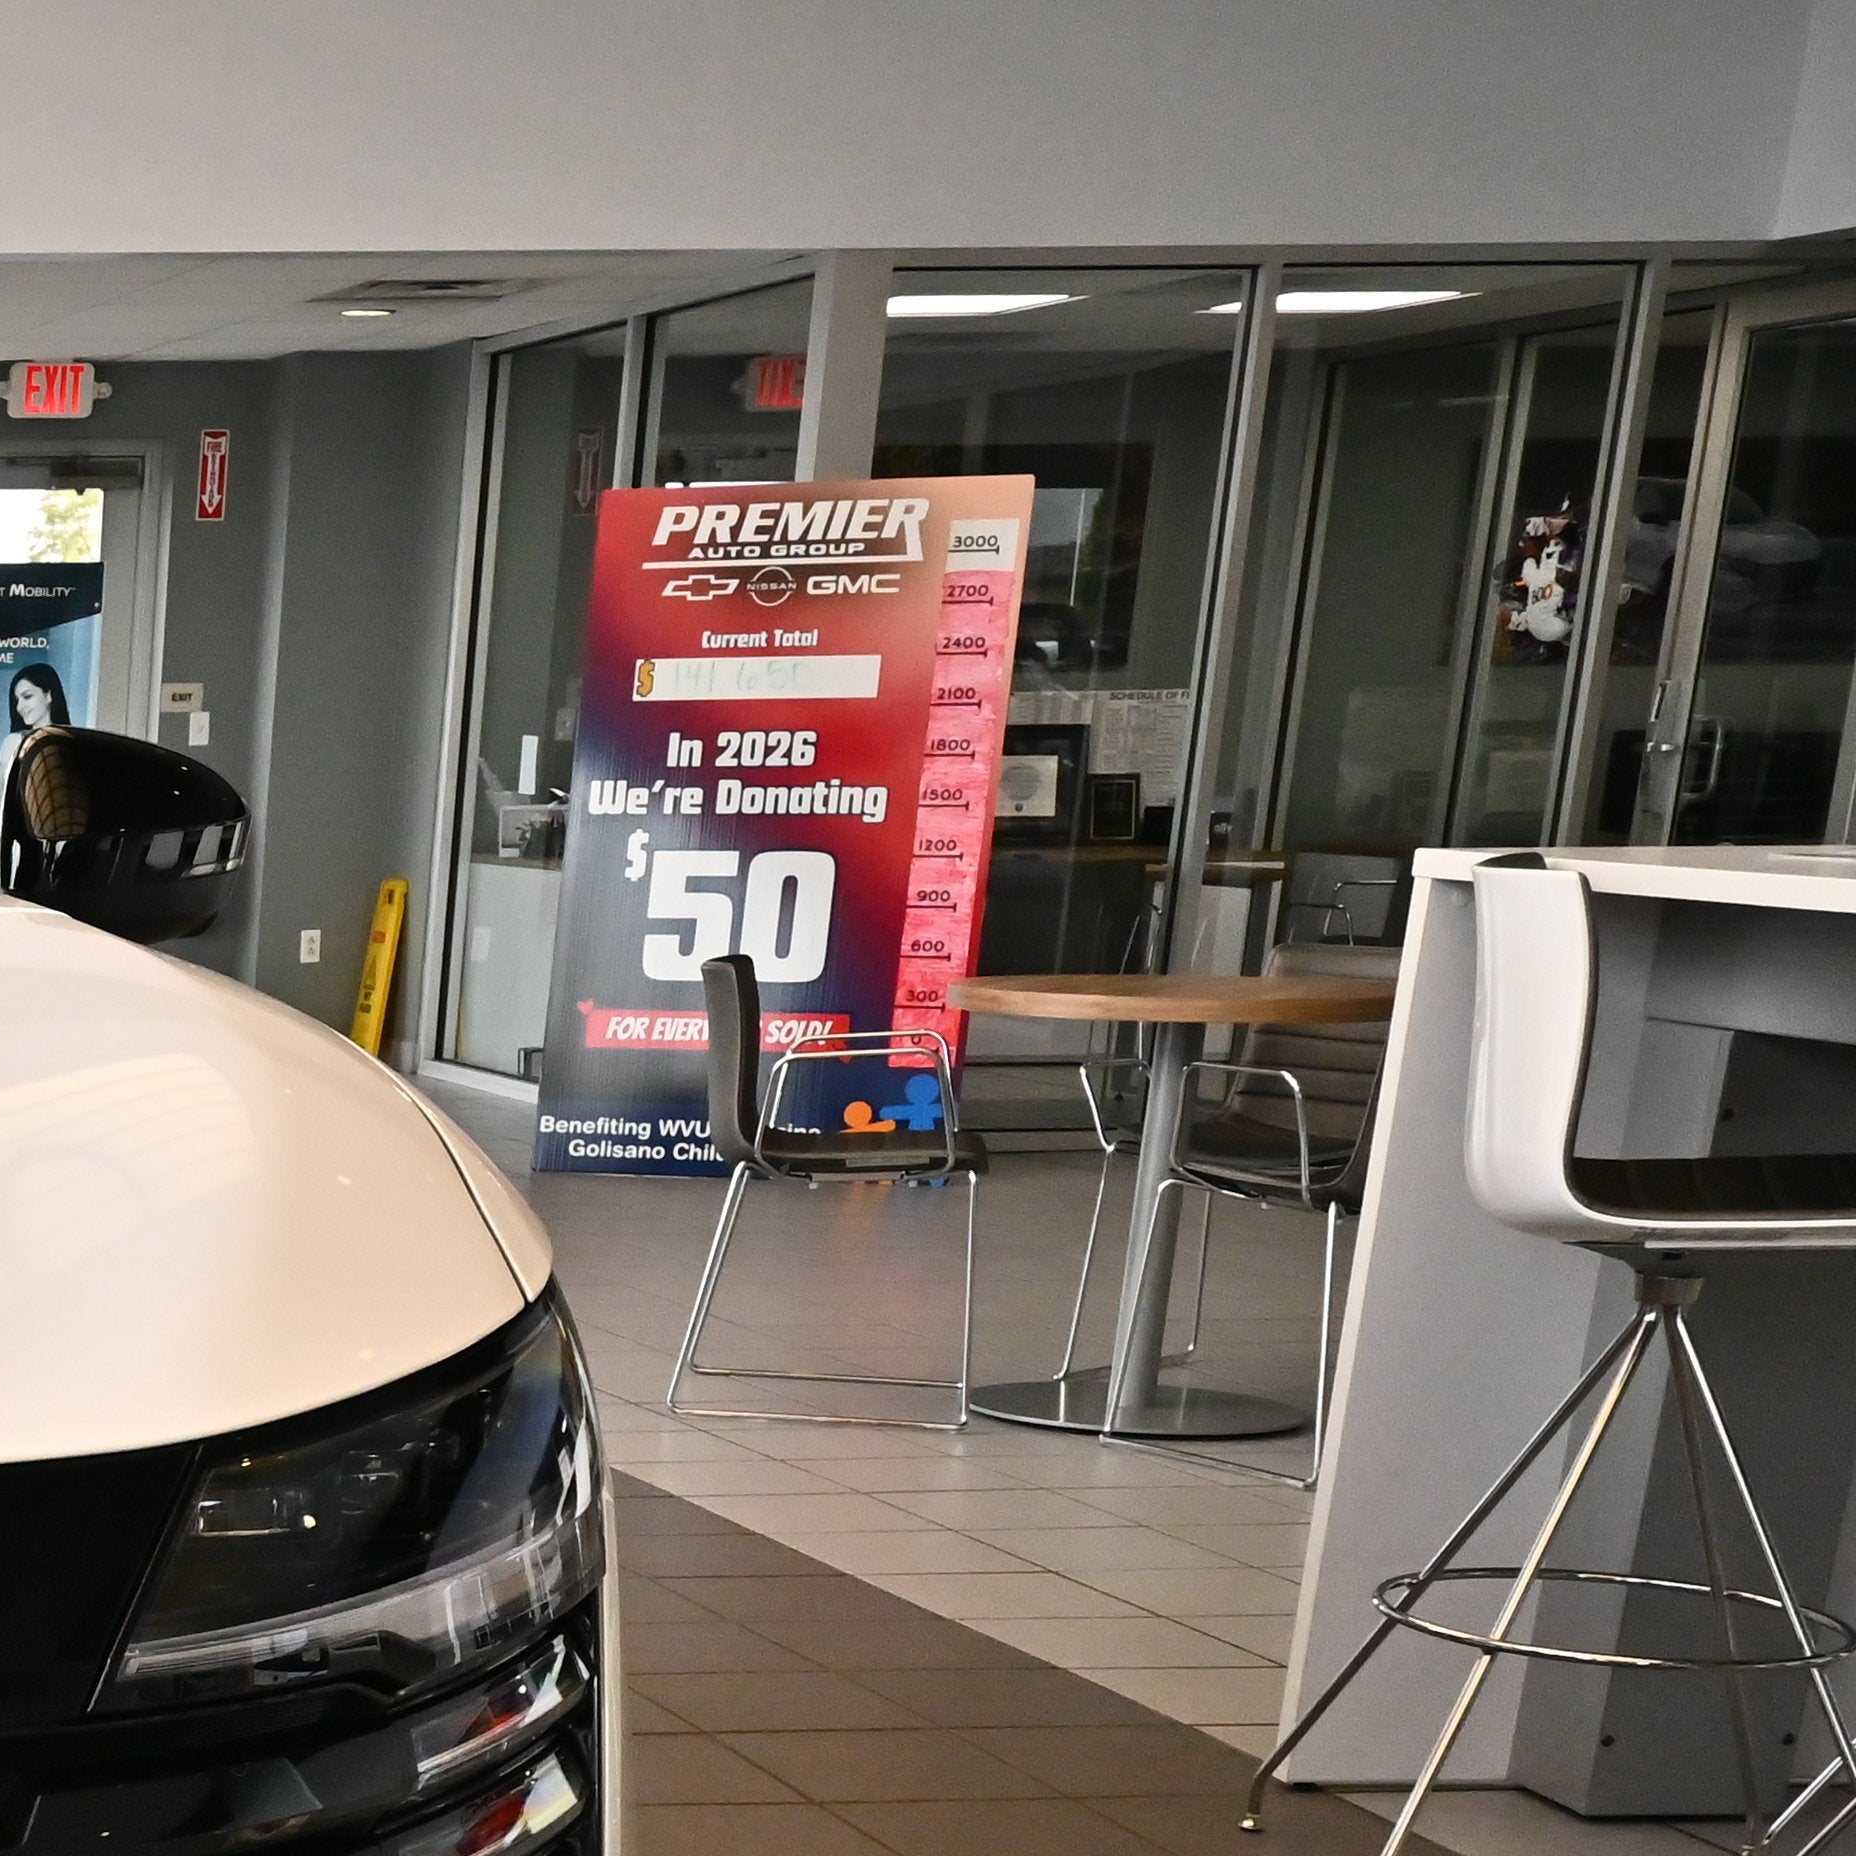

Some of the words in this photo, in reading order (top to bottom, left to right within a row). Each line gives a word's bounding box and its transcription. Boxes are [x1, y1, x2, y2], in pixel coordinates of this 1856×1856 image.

[24, 365, 87, 414] EXIT
[651, 498, 930, 556] PREMIER
[952, 534, 999, 548] 3000
[688, 546, 761, 559] AUTO
[770, 543, 866, 557] GROUP
[746, 582, 797, 592] NISSAN
[806, 574, 902, 595] GMC
[945, 584, 989, 598] 2700
[701, 630, 768, 649] Current
[773, 628, 820, 648] Total
[941, 636, 987, 650] 2400
[936, 687, 977, 700] 2100
[666, 732, 703, 768] In
[715, 730, 818, 767] 2026
[930, 738, 972, 752] 1800
[588, 778, 704, 816] We're
[715, 777, 889, 824] Donating
[921, 788, 964, 802] 1500
[918, 839, 958, 852] 1200
[916, 890, 952, 903] 900
[910, 940, 946, 953] 600
[906, 990, 938, 1002] 300
[605, 1016, 650, 1041] FOR
[539, 1115, 651, 1140] Benefiting
[658, 1119, 711, 1138] WVU
[568, 1139, 666, 1161] Golisano
